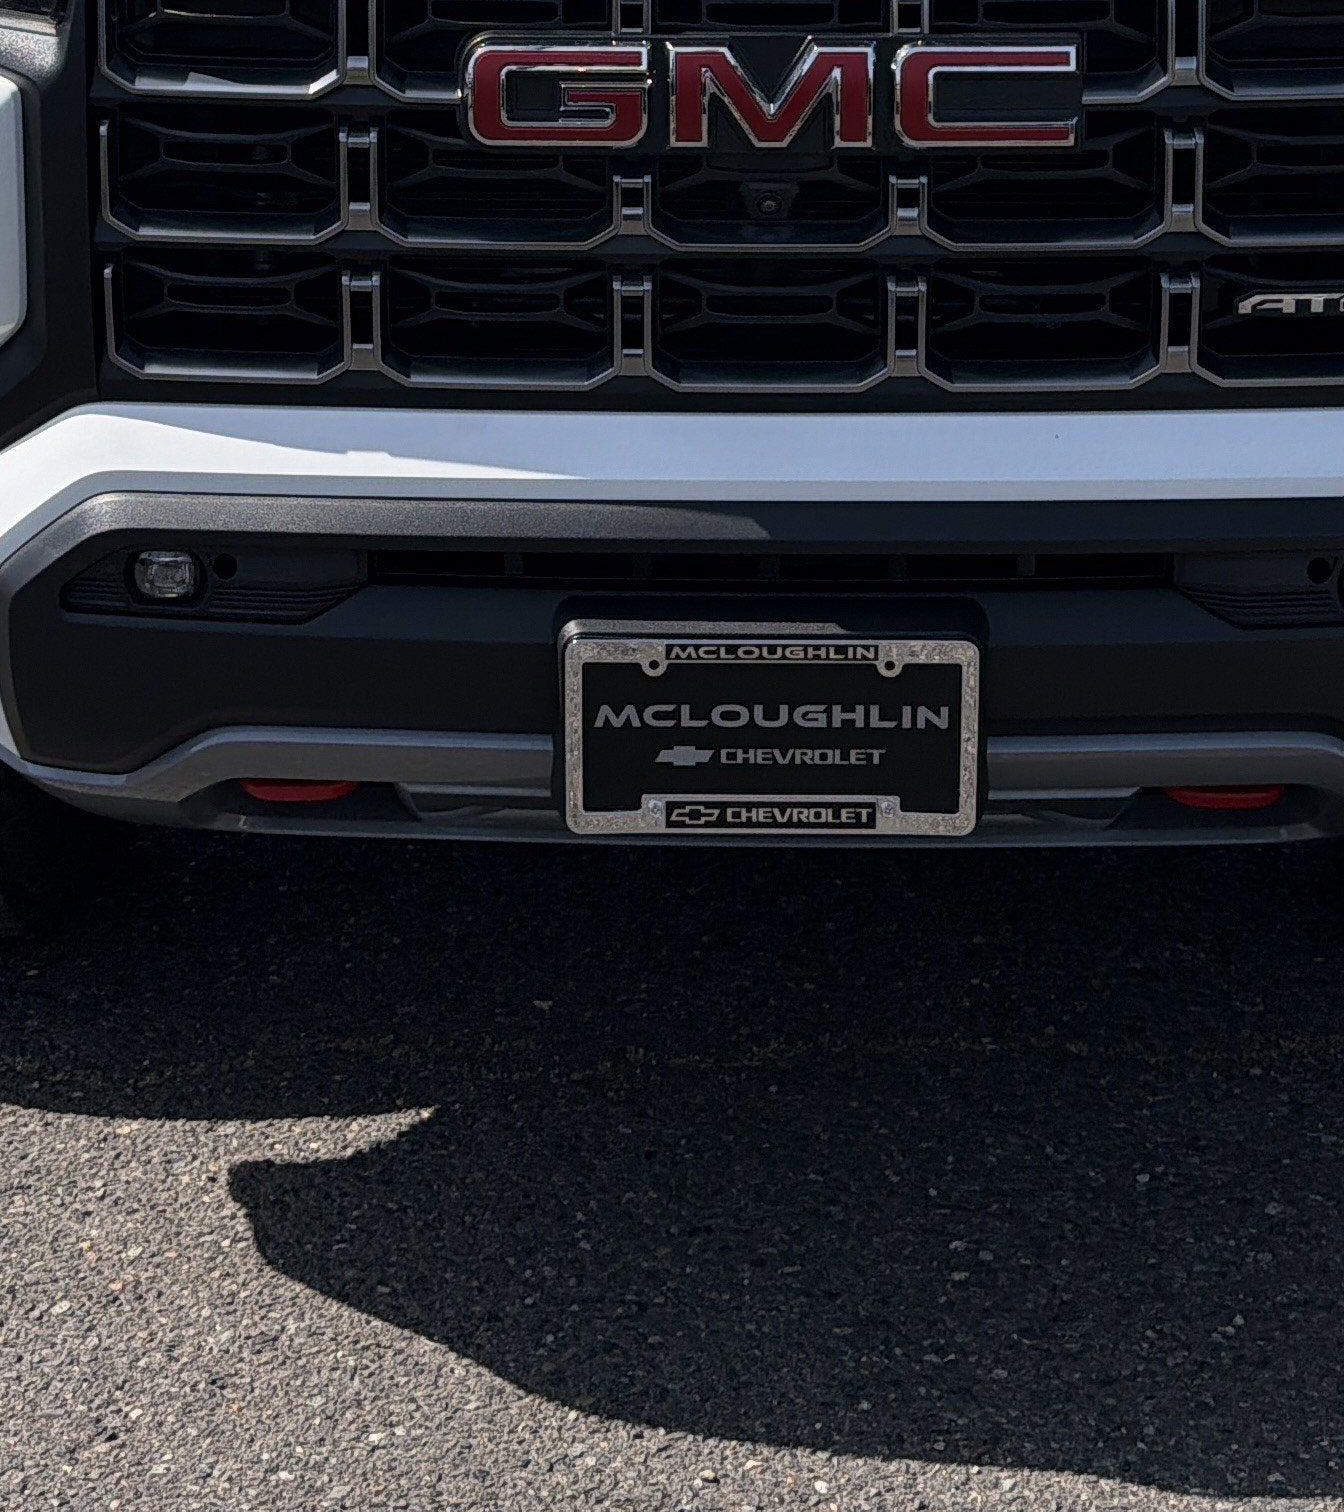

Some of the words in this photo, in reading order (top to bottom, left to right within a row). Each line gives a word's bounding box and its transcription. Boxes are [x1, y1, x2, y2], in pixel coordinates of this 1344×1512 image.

[465, 36, 1079, 149] GMC
[669, 645, 876, 660] MCLOUGHLIN
[594, 704, 950, 730] MCLOUGHLIN
[719, 748, 887, 766] CHEVROLET
[725, 807, 873, 824] CHEVROLET
